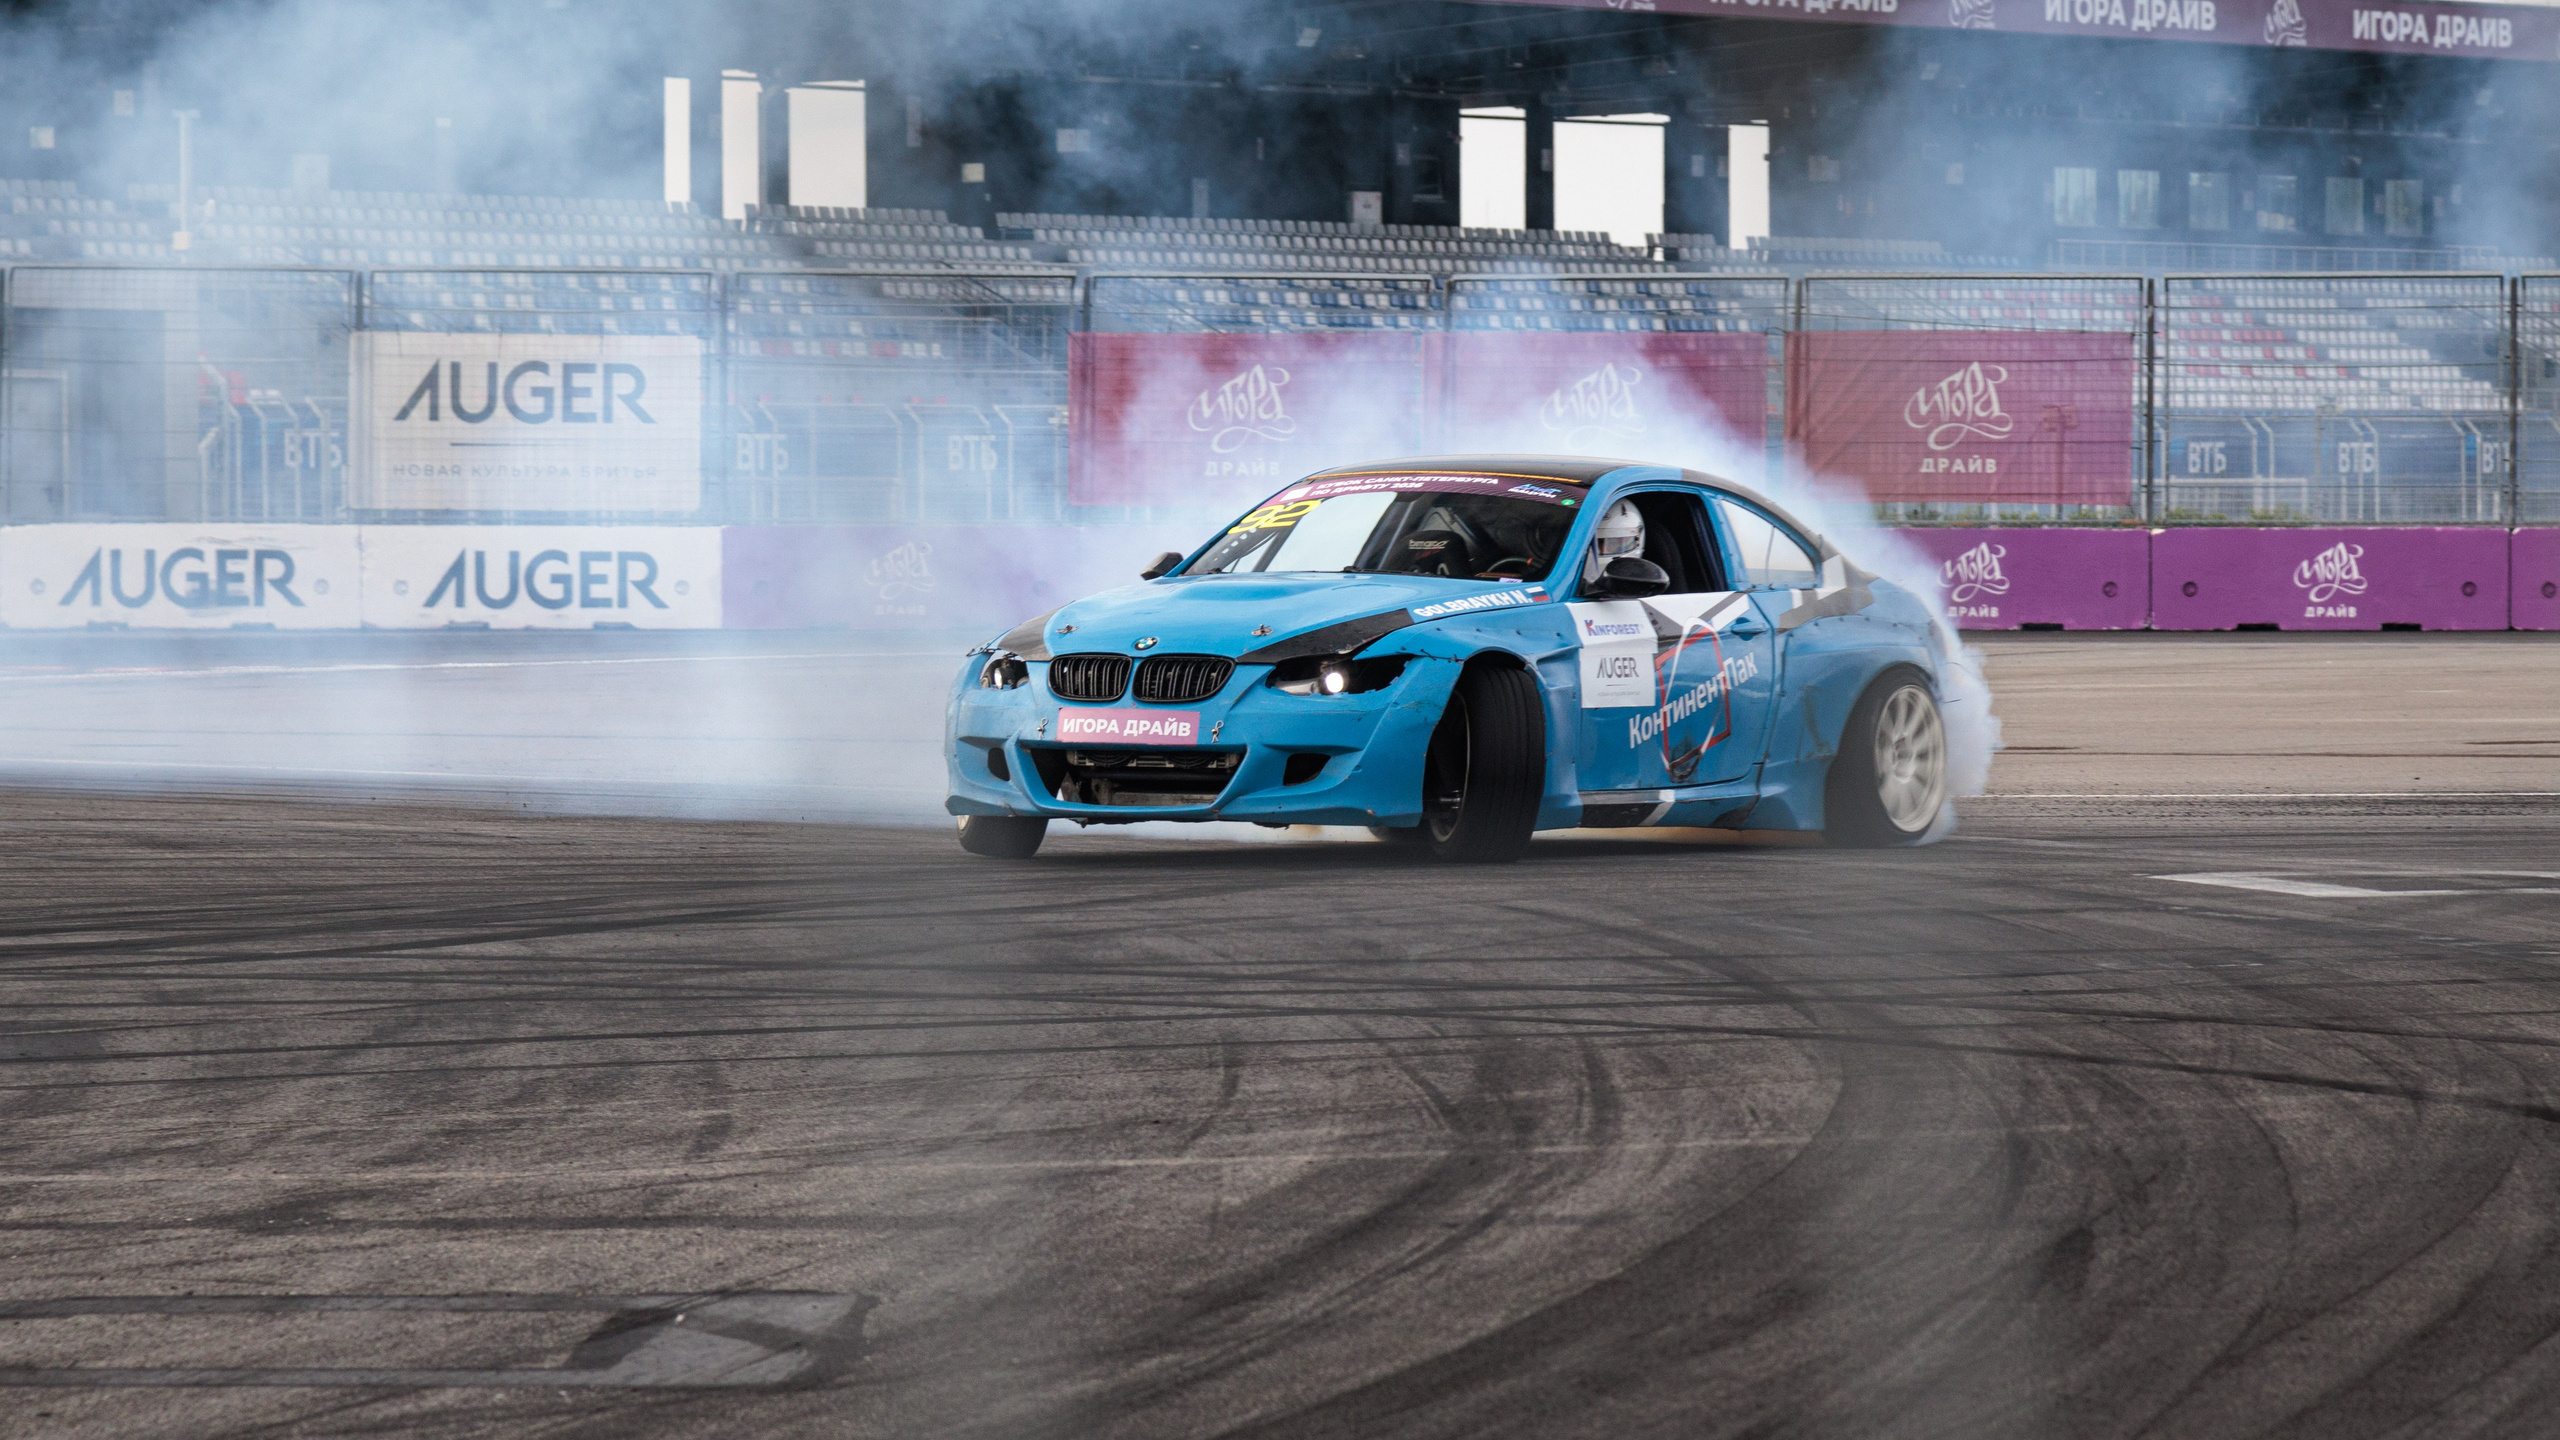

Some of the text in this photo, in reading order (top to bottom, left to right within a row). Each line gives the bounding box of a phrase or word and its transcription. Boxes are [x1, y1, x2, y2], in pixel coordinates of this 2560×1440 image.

[2045, 0, 2127, 26] ИГОРА
[2352, 9, 2429, 44] ИГОРА
[393, 358, 658, 424] AUGER
[736, 434, 789, 470] ВТБ
[949, 435, 998, 470] ВТБ
[1919, 455, 1998, 473] ДРАЙВ
[2188, 442, 2227, 474] ВТБ
[2338, 442, 2375, 473] ВТБ
[394, 463, 462, 477] НОВАЯ
[471, 464, 571, 478] КУЛЬТУРА
[1204, 457, 1281, 476] ДРАЙВ
[1310, 488, 1331, 496] ПО
[1316, 479, 1364, 490] КУБОК
[1228, 499, 1322, 535] 92
[58, 546, 307, 609] AUGER
[422, 547, 670, 610] AUGER
[1413, 591, 1516, 617] GOLBRAYKH
[1947, 604, 2000, 618] ДРАЙВ
[2304, 604, 2357, 618] ДРАЙВ
[1597, 657, 1640, 679] AUGER
[1629, 652, 1759, 749] КонтинентПак
[1063, 717, 1192, 737] ИГОРА ДРАЙВ
